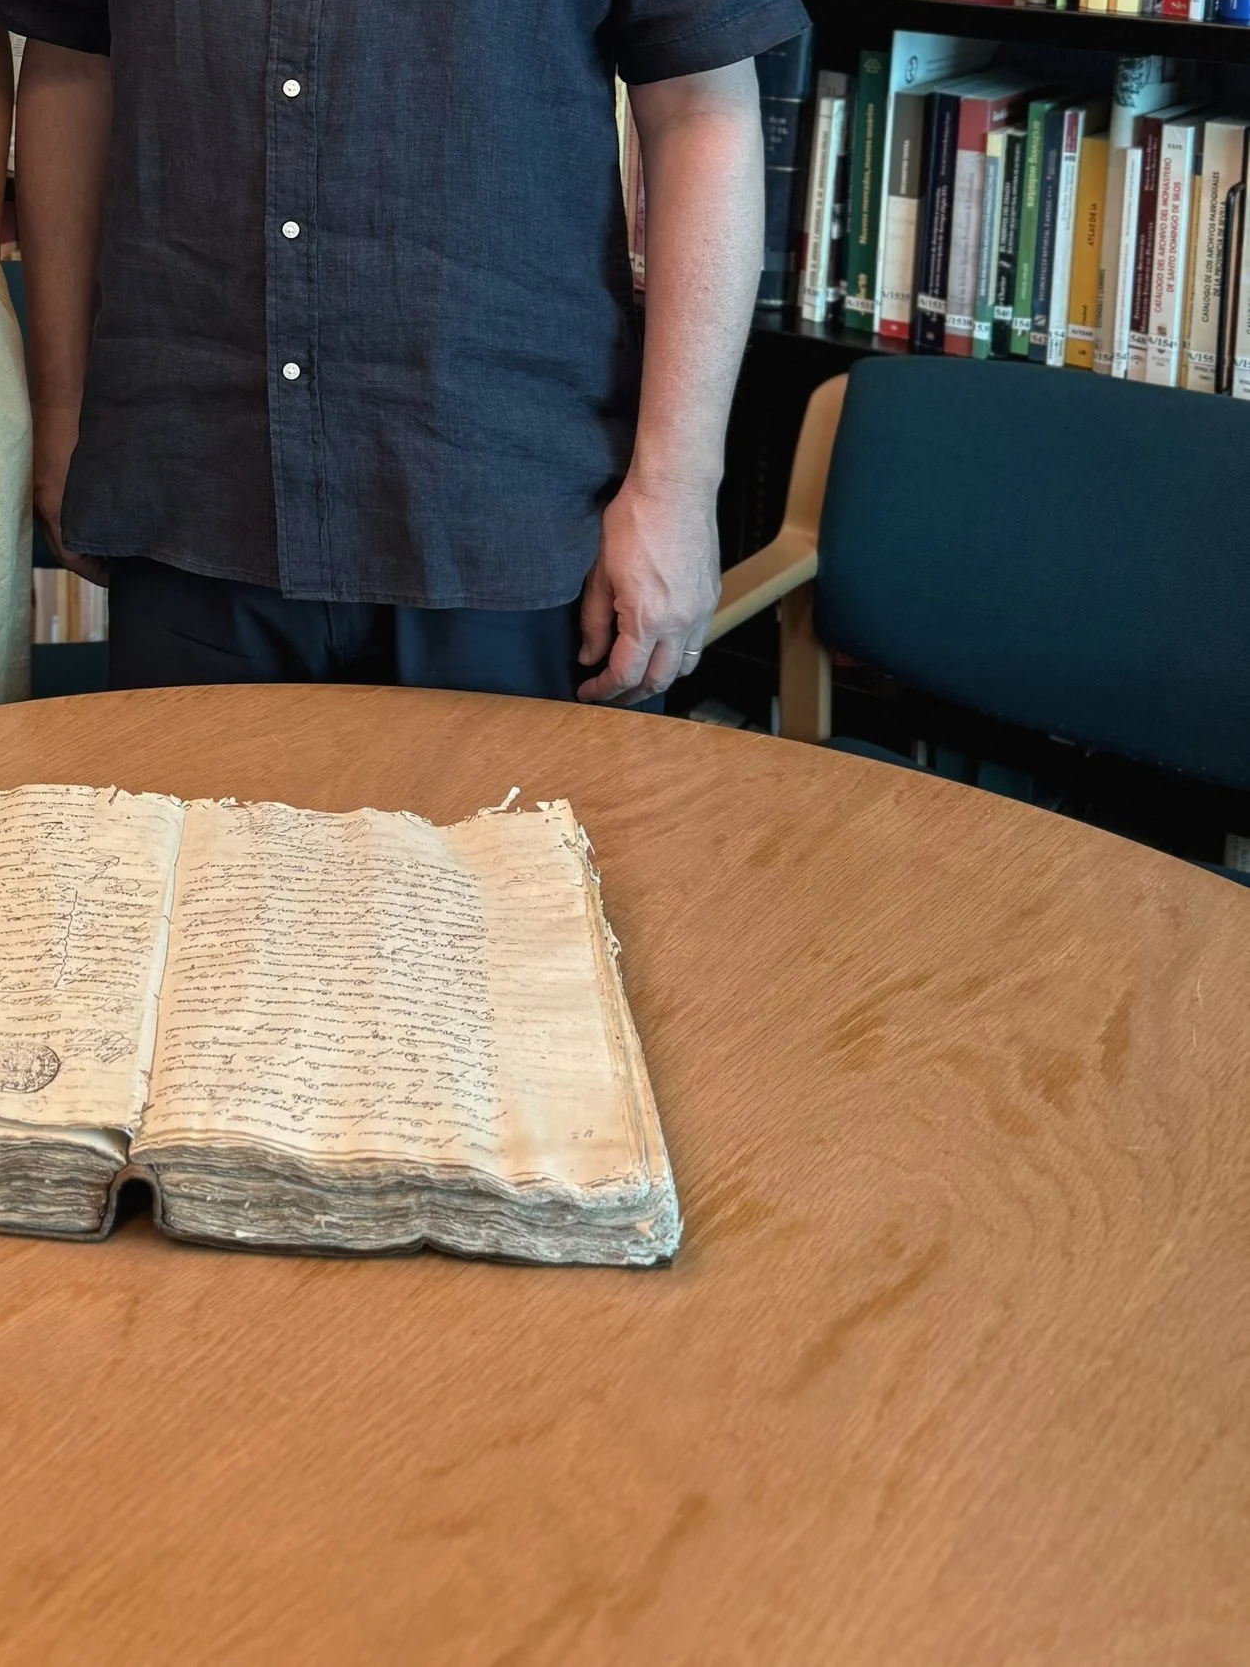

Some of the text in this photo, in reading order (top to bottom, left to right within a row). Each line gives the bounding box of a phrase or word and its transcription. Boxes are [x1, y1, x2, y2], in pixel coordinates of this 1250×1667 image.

[1023, 120, 1044, 207] archiving websites
[859, 213, 868, 244] Nuevos
[1154, 157, 1172, 313] CATÁLOGO DEL ARCHIVO DEL MONASTERIO
[1167, 182, 1181, 292] DE SANTO DOMINGO DE SILOS
[1205, 223, 1217, 258] ARCHIVOS
[1205, 260, 1214, 273] LOS
